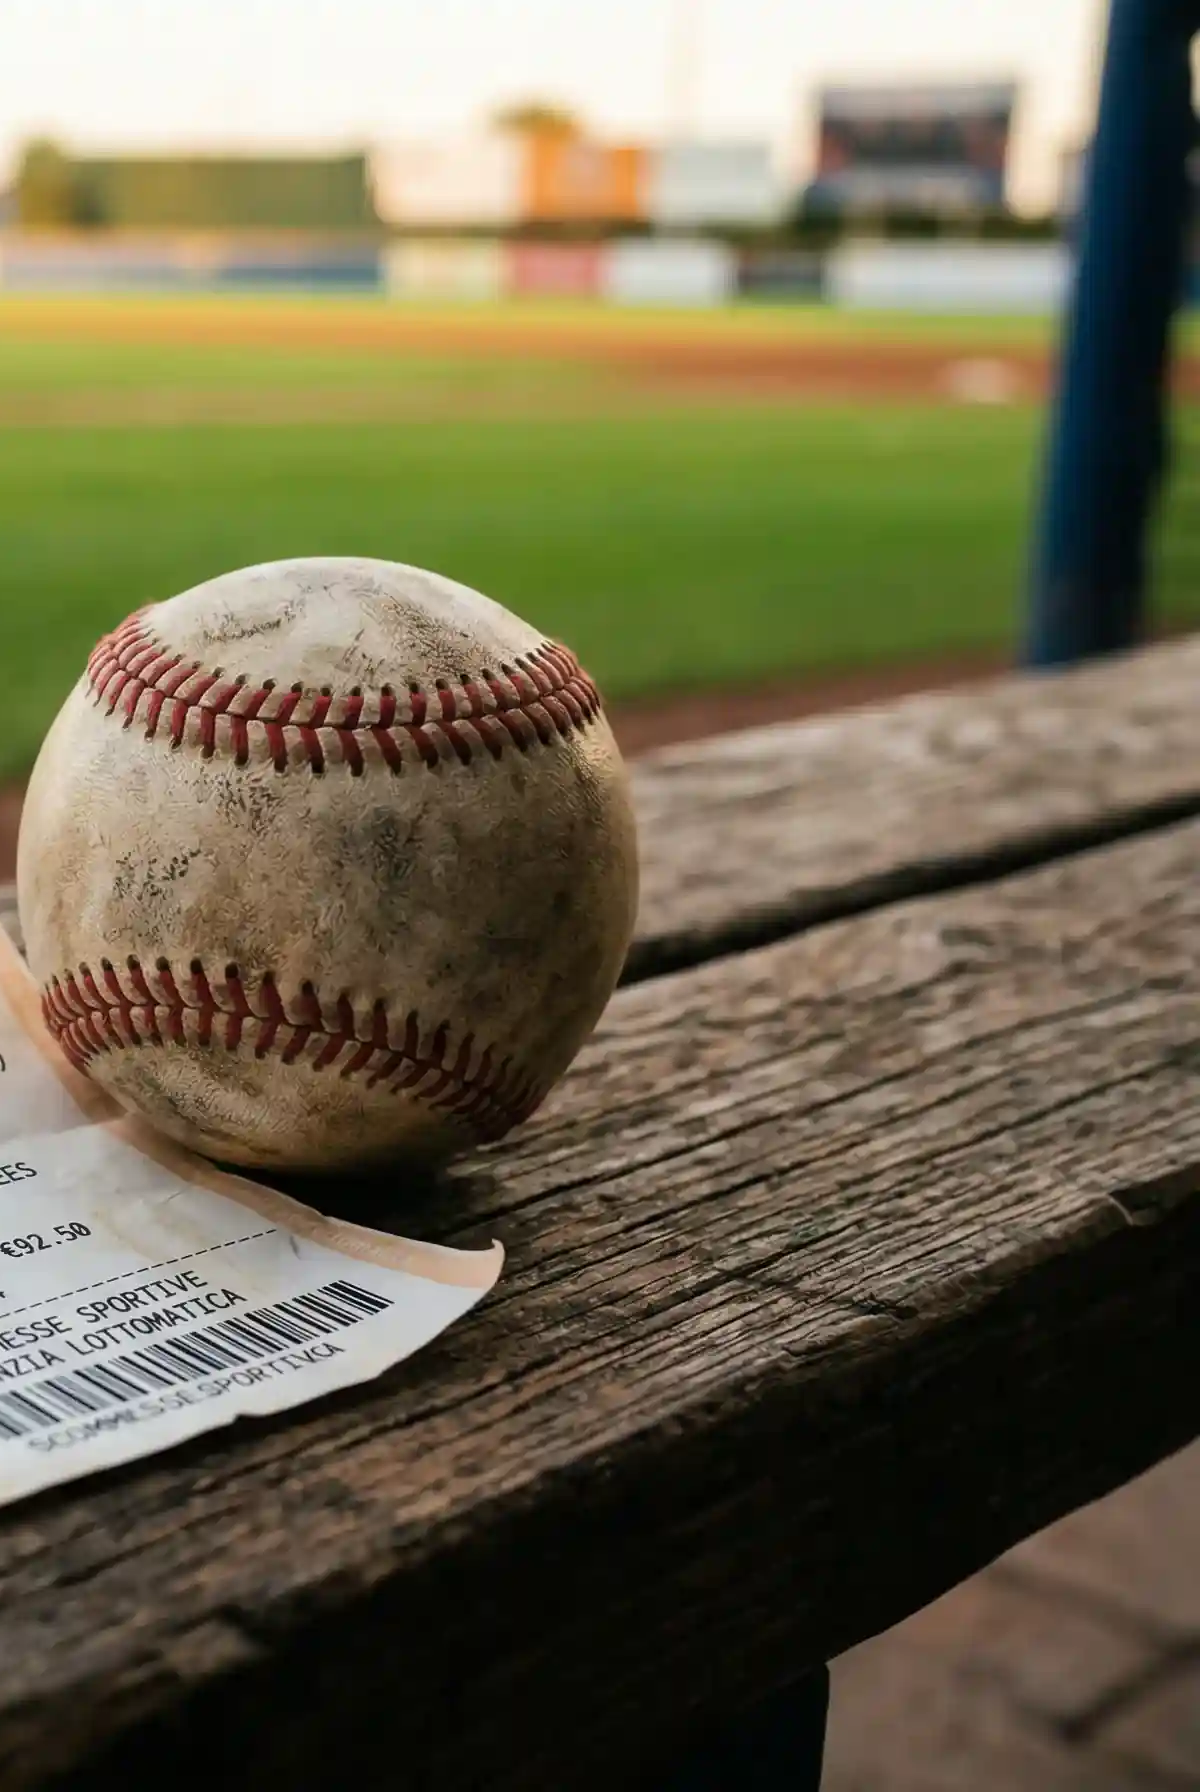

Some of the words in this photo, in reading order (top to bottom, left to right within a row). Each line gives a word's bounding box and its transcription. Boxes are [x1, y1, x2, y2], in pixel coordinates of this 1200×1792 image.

[0, 1222, 92, 1258] €92.50
[65, 1288, 248, 1356] LOTTOMATICA
[76, 1270, 209, 1324] SPORTIVE
